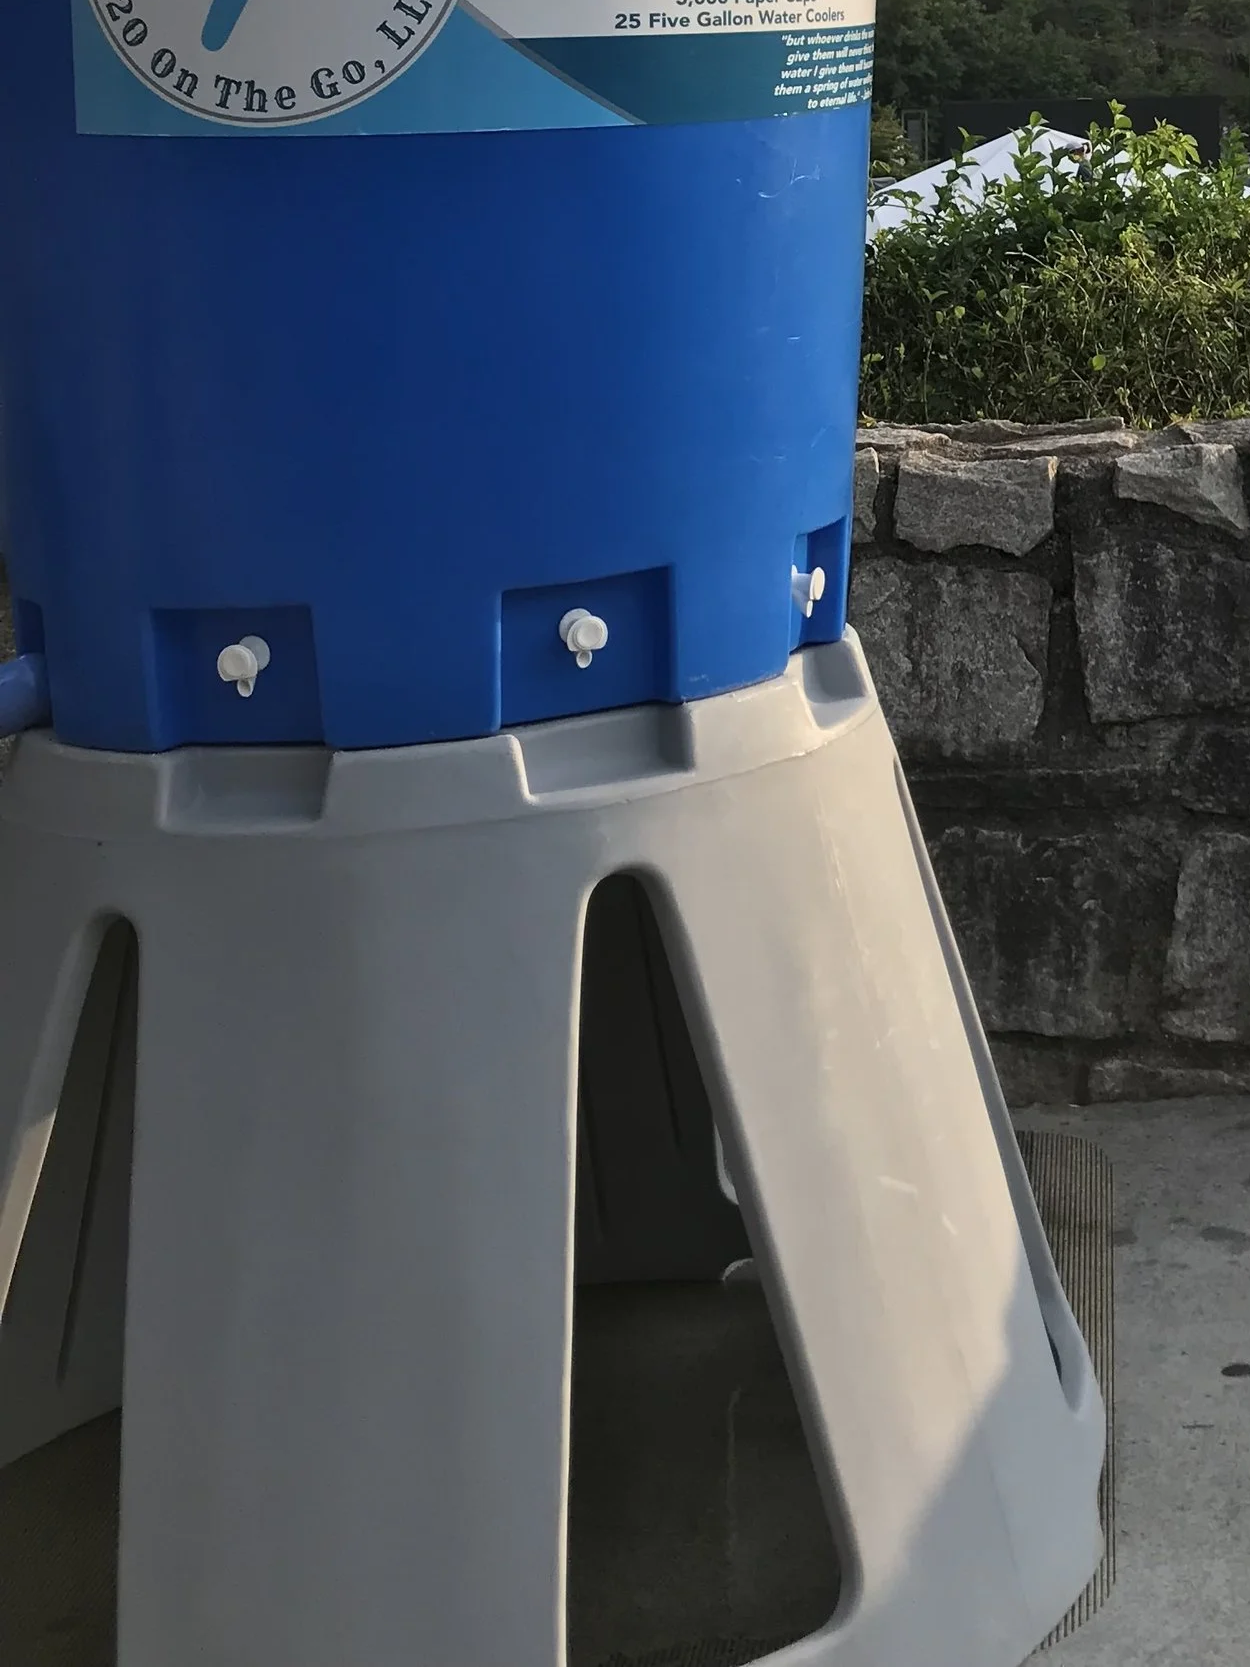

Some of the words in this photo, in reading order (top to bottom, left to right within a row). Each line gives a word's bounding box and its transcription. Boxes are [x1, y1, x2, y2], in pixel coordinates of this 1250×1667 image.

[615, 13, 641, 29] 25
[650, 12, 690, 28] Five
[697, 10, 753, 27] Gallon
[759, 9, 802, 25] Water
[806, 7, 845, 23] Coolers
[808, 32, 844, 45] whoever
[786, 51, 810, 66] give
[813, 48, 835, 61] them
[151, 48, 199, 99] On
[214, 74, 297, 113] The
[310, 59, 386, 101] Go,
[781, 67, 813, 79] water
[818, 64, 837, 79] give
[774, 83, 802, 96] them
[804, 85, 811, 94] a
[813, 80, 839, 95] spring
[840, 76, 849, 90] of
[808, 98, 818, 109] to
[820, 92, 847, 108] eternal
